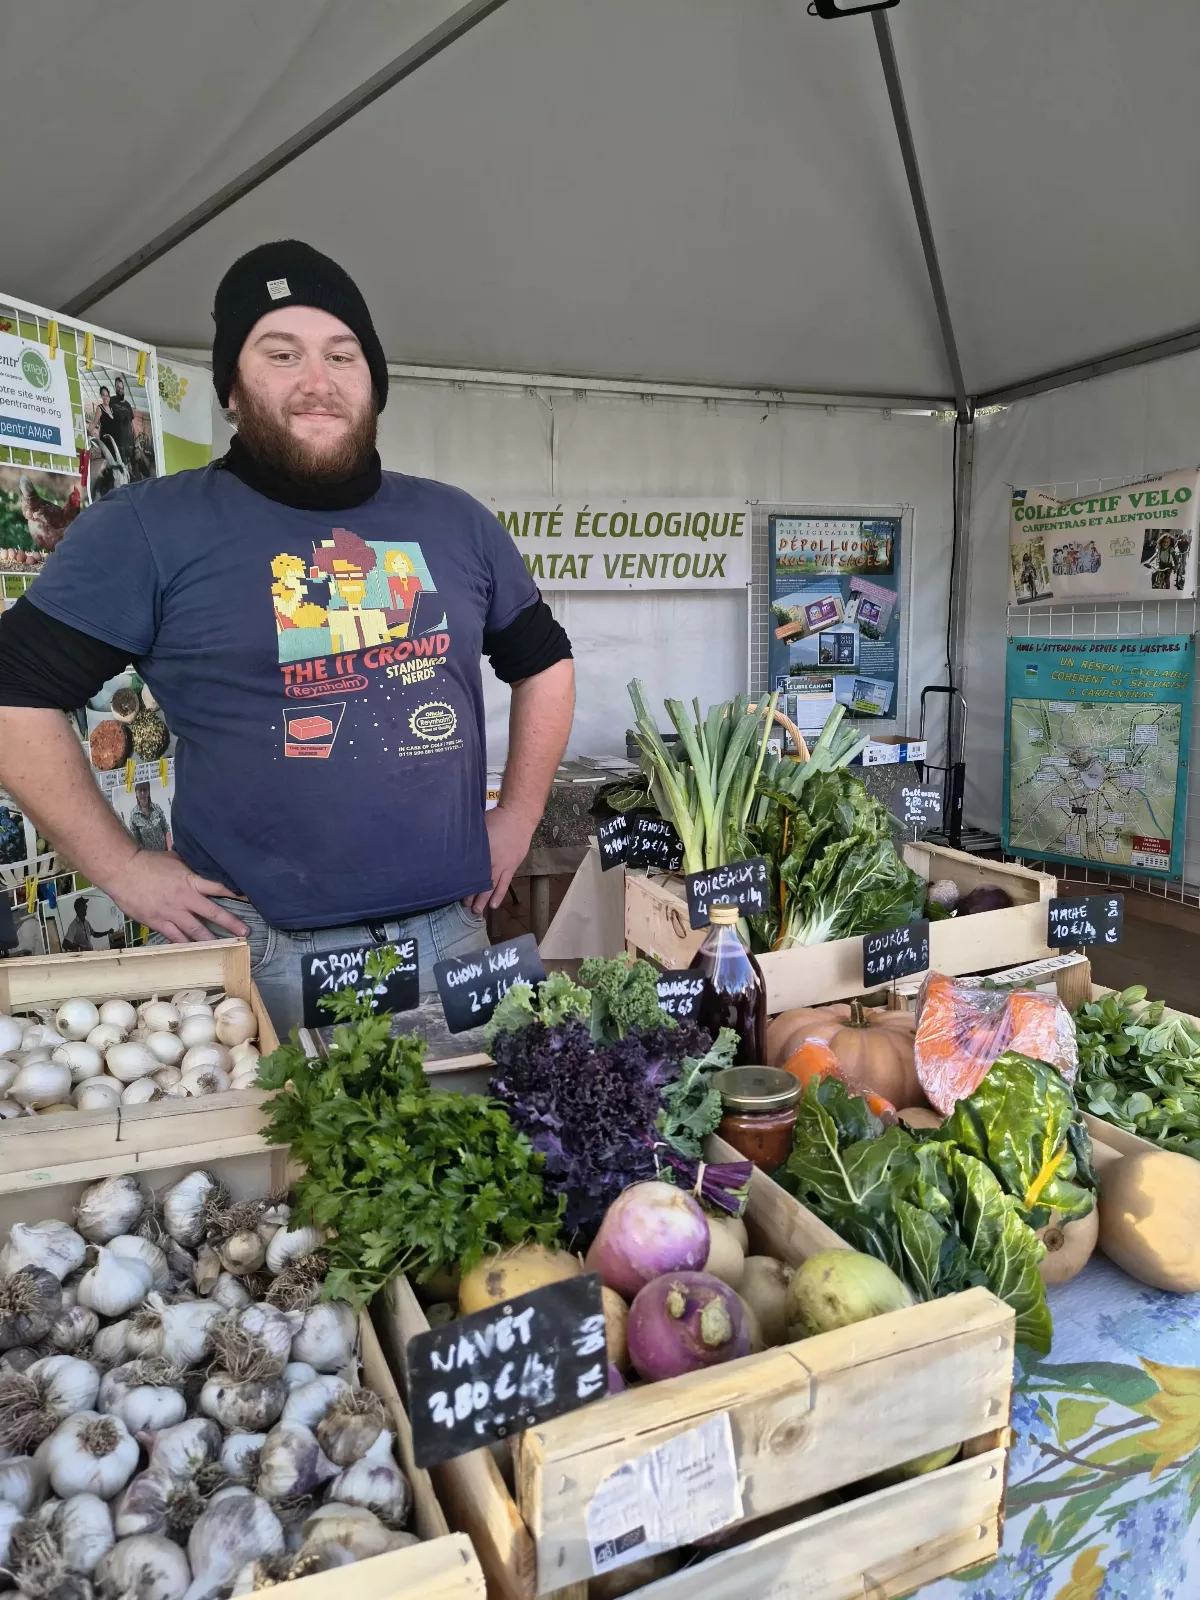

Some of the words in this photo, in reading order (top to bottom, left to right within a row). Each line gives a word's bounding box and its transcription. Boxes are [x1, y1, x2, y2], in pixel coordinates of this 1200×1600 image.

[18, 390, 33, 400] site
[36, 395, 55, 404] web!
[1014, 495, 1122, 521] COLLECTIF
[1127, 487, 1192, 508] VELO
[574, 505, 746, 541] ÉCOLOGIQUE
[1022, 519, 1086, 533] CARPENTRAS
[1088, 517, 1103, 526] ET
[1105, 509, 1178, 525] ALENTOURS
[778, 536, 881, 551] DÉPOLLUONS
[602, 553, 728, 579] VENTOUX
[779, 553, 806, 566] NOS
[814, 553, 882, 567] PAYSAGES
[281, 658, 327, 684] THE
[336, 653, 357, 674] IT
[364, 633, 451, 669] CROWD
[1089, 643, 1118, 653] DEPUIS
[1120, 644, 1137, 653] DES
[1139, 642, 1180, 653] LUSTRES
[386, 656, 447, 678] STANDARD
[402, 666, 436, 685] NERDS
[1060, 657, 1075, 667] UN
[1080, 658, 1124, 674] RÉSEAU
[1129, 668, 1191, 684] CYCLABLE
[1080, 688, 1156, 699] CARPENTRAS
[1111, 678, 1123, 686] et
[693, 865, 754, 896] POIREAUX
[430, 1306, 536, 1373] NAVET
